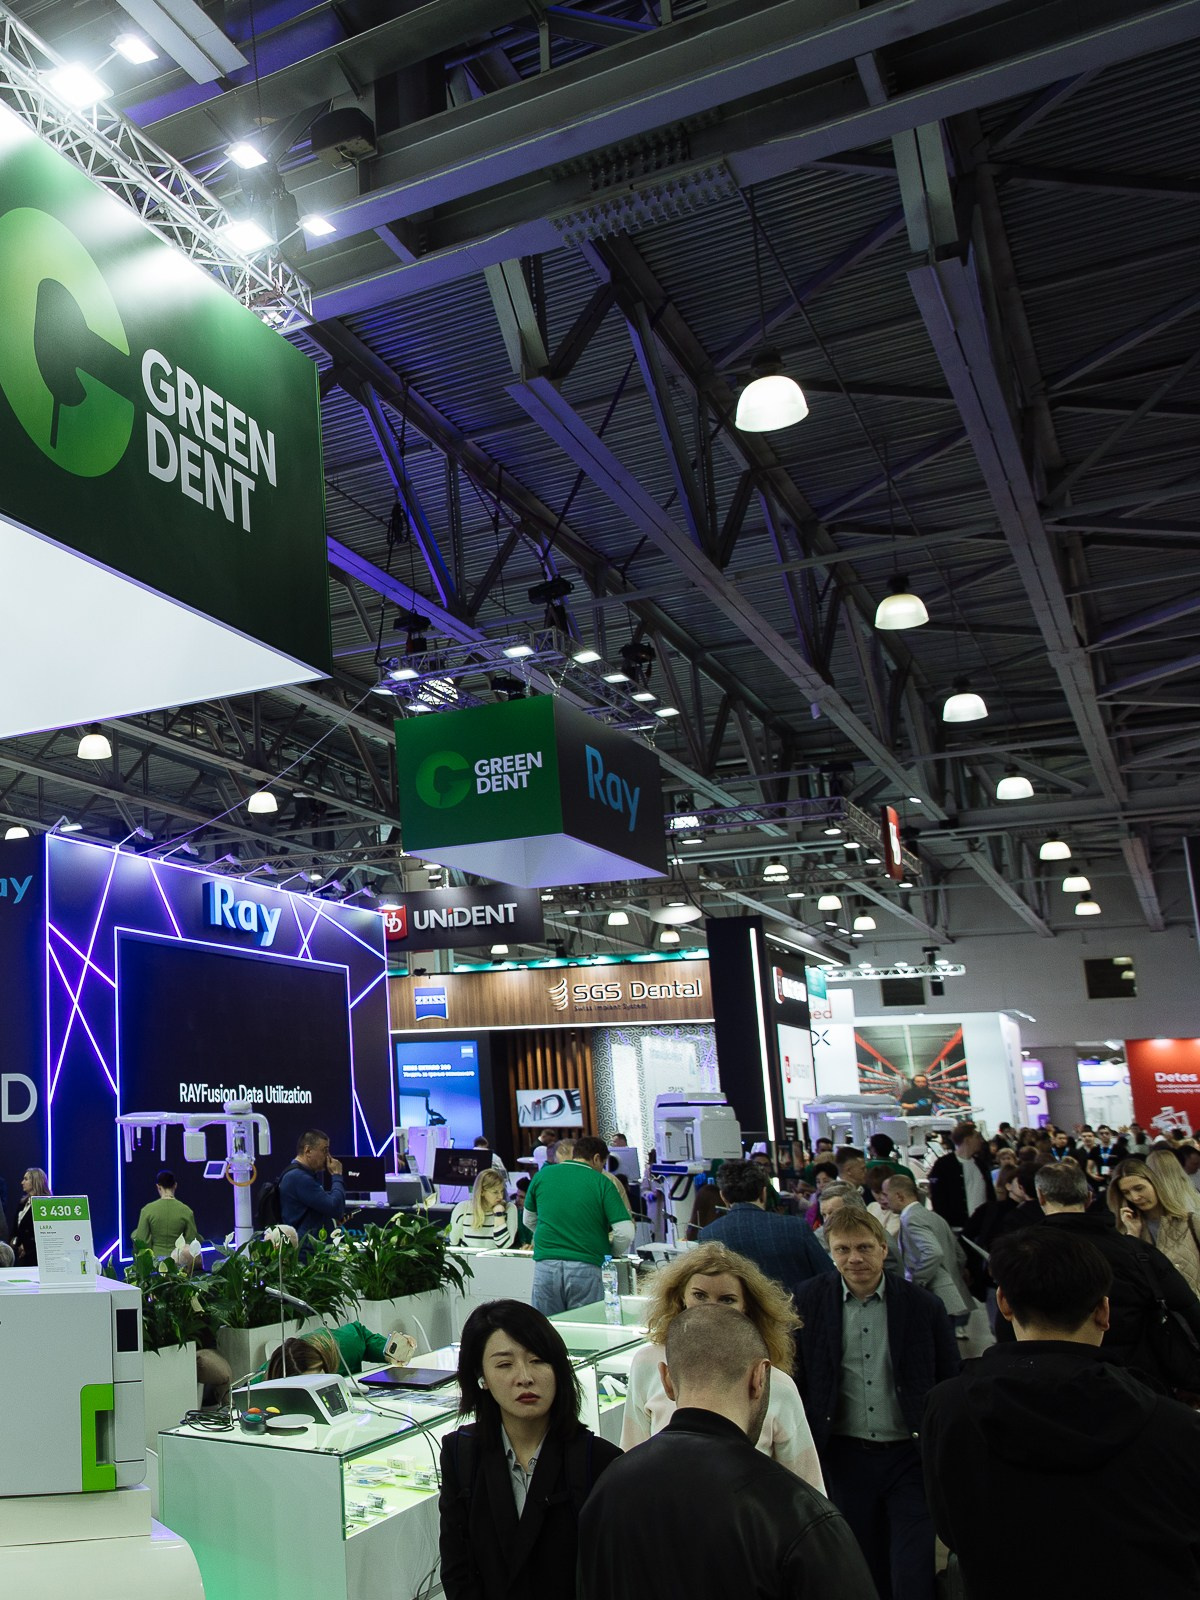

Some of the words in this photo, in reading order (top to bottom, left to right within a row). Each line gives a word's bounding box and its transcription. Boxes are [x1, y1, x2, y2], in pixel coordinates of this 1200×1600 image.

[141, 348, 277, 488] GREEN
[146, 411, 256, 533] DENT
[474, 751, 543, 777] GREEN
[476, 770, 531, 795] DENT
[585, 744, 641, 832] Ray
[209, 881, 282, 947] Ray
[415, 995, 446, 1005] ZEISS
[572, 982, 622, 1003] SGS
[629, 979, 703, 1000] Dental
[1154, 1072, 1198, 1083] Detes
[179, 1082, 237, 1103] RAYFusion
[238, 1084, 264, 1103] Data
[264, 1085, 313, 1104] Utilization
[40, 1206, 47, 1217] 3
[50, 1205, 72, 1217] 430
[74, 1205, 82, 1216] €
